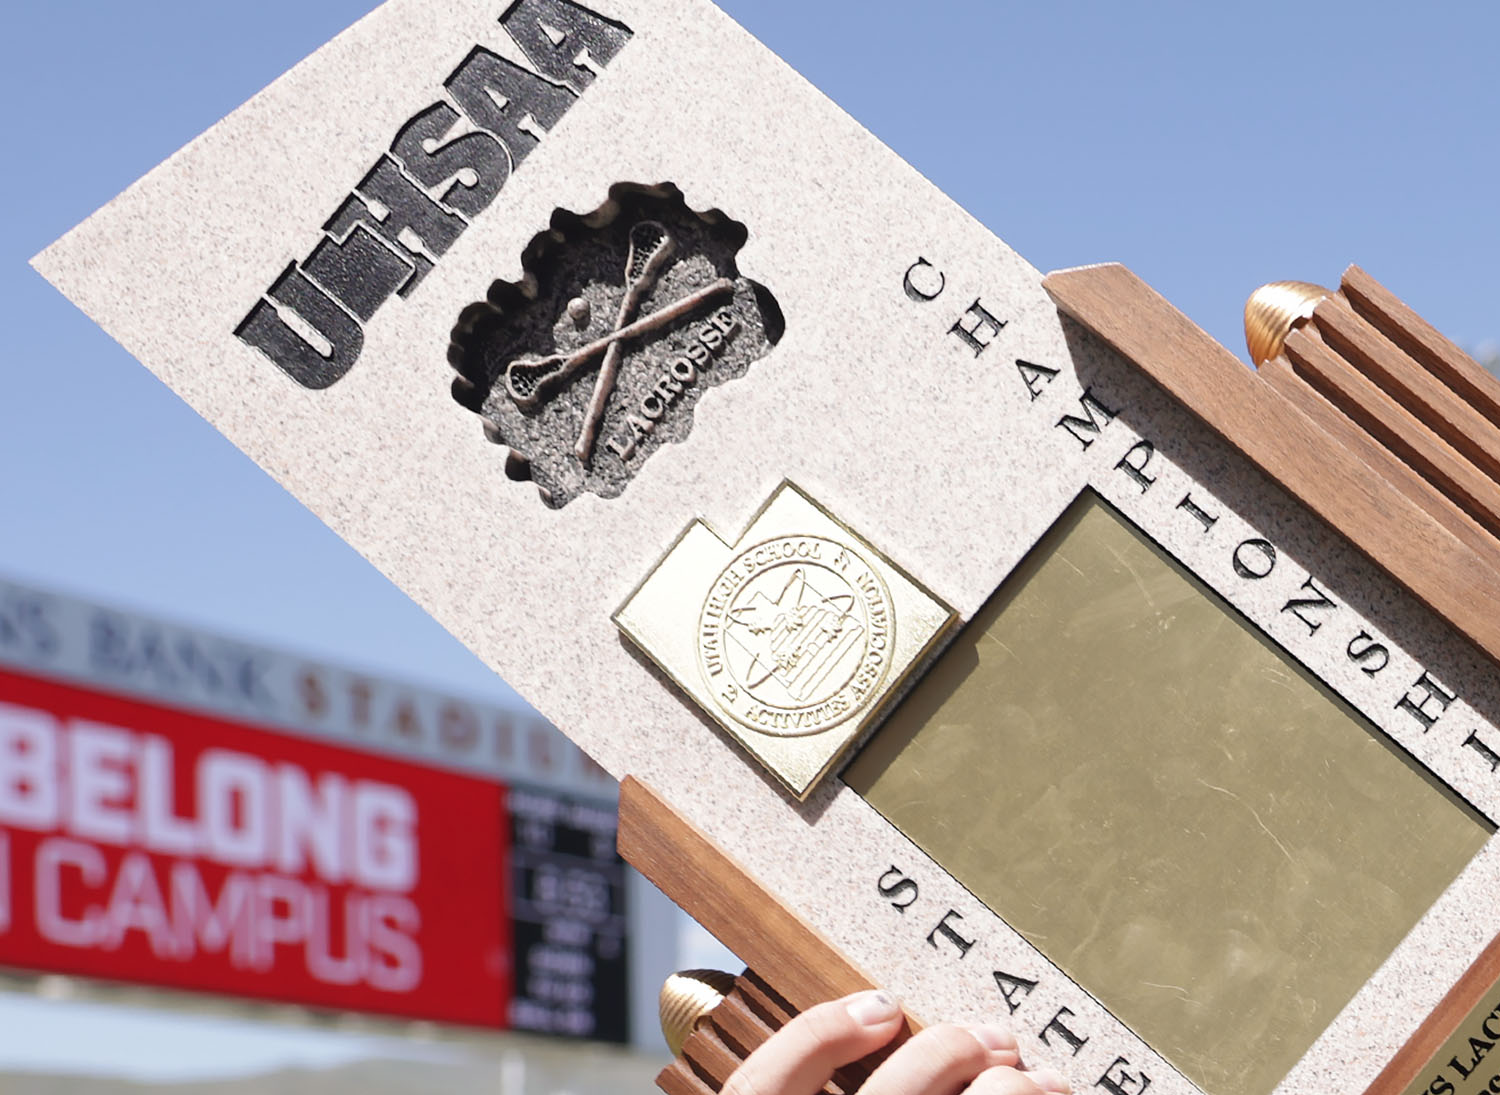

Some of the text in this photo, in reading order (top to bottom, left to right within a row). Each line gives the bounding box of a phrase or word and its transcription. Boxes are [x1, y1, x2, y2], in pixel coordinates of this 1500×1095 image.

[606, 311, 739, 461] LACROSSE
[92, 610, 272, 704] BANK
[703, 541, 822, 679] UTAH HIGH SCHOOL
[746, 572, 888, 730] ACTIVITIES ASSOCIATION
[0, 705, 418, 893] BELONG
[34, 842, 422, 992] CAMPUS
